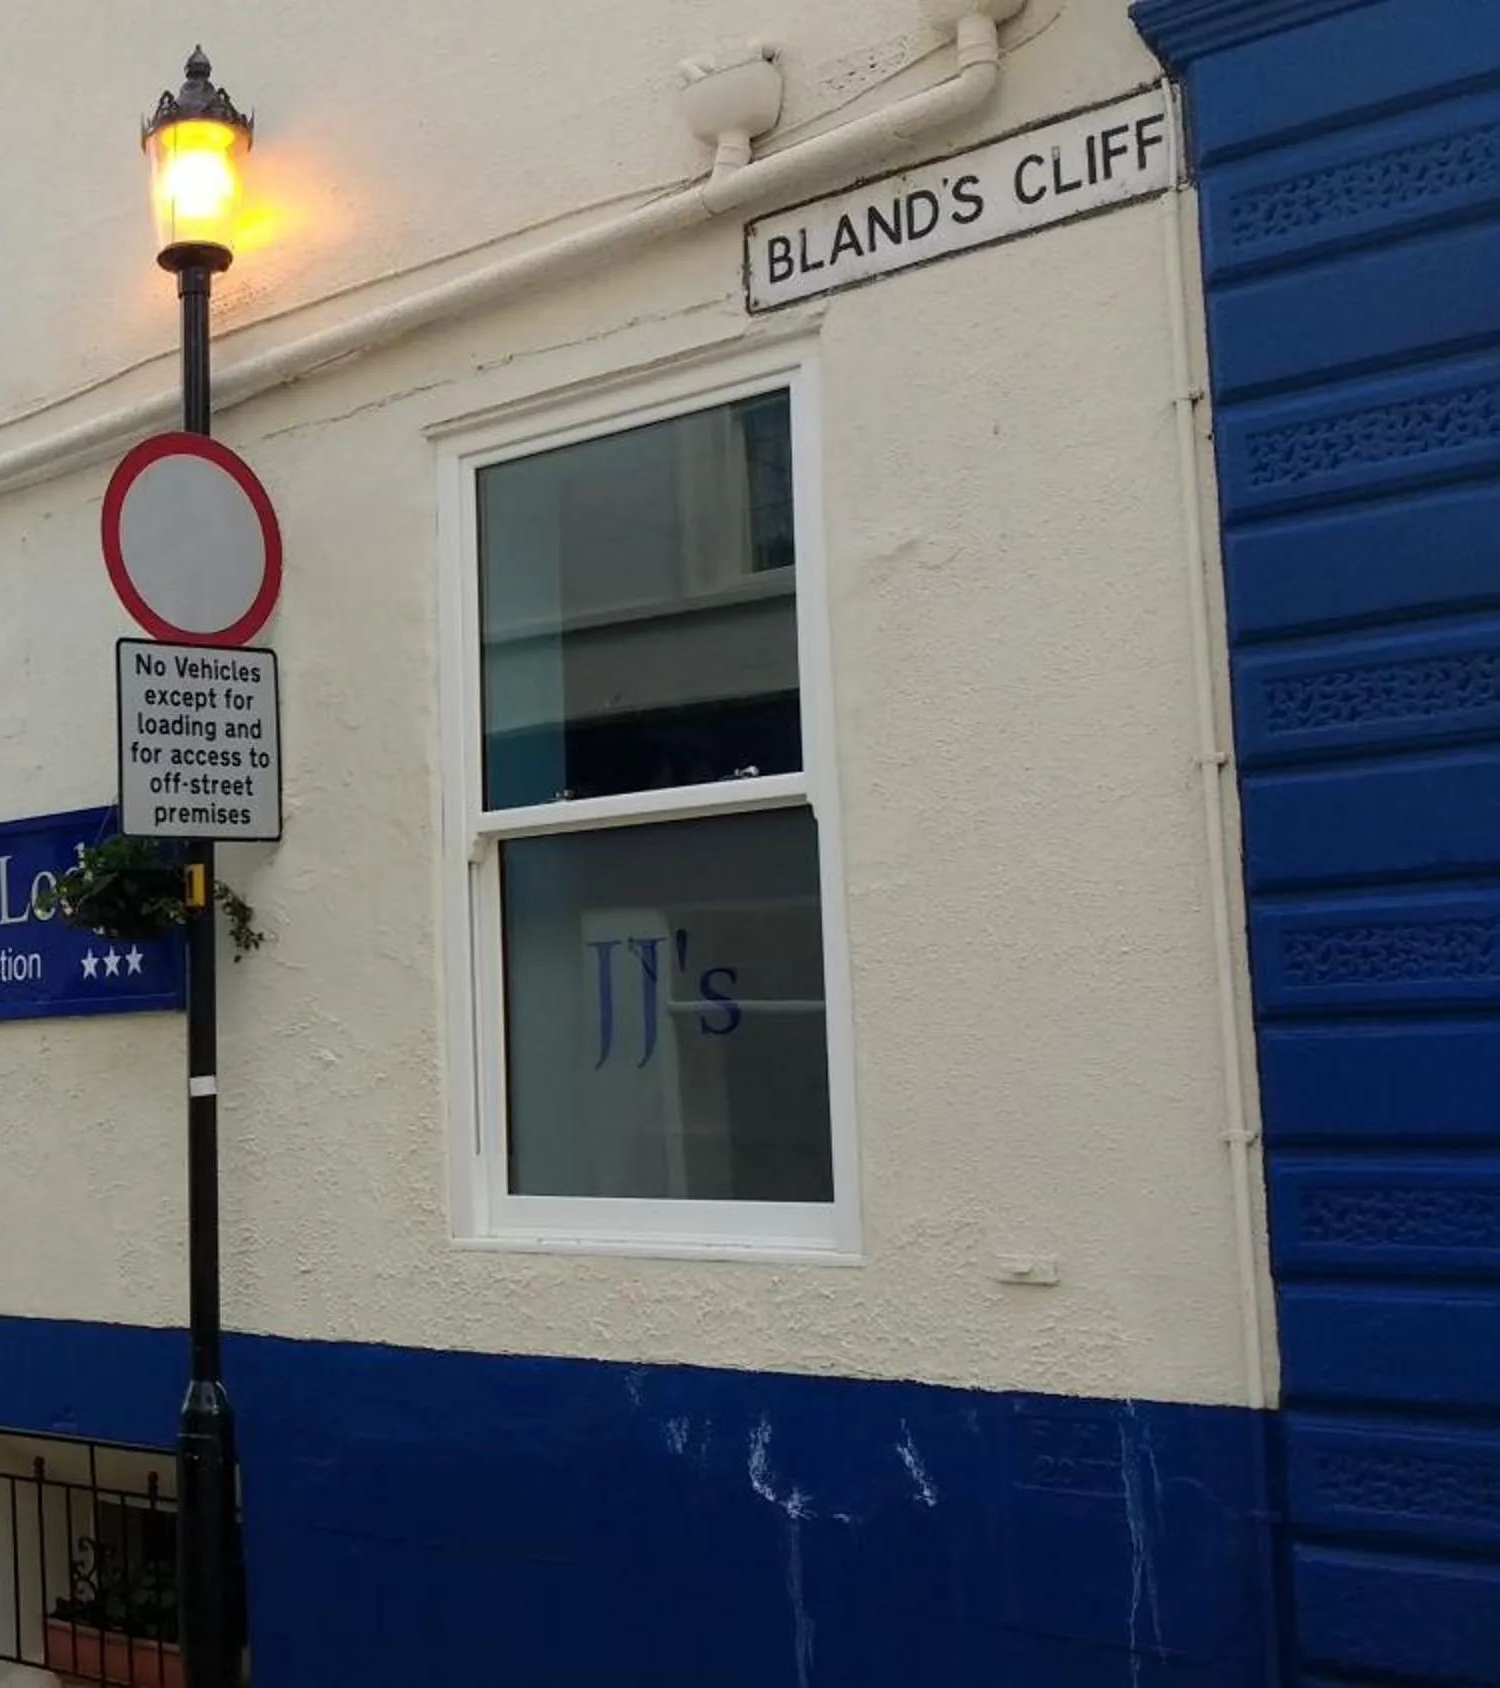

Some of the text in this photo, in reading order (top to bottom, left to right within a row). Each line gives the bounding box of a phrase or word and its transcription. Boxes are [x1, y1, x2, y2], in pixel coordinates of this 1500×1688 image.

[767, 113, 1166, 285] BLAND'S CLIFF
[135, 653, 261, 684] No Vehicles
[144, 687, 254, 712] except for
[137, 711, 262, 742] loading and
[130, 741, 271, 769] for access to
[149, 771, 254, 797] off-street
[154, 803, 252, 827] premises
[585, 928, 742, 1072] JJ's
